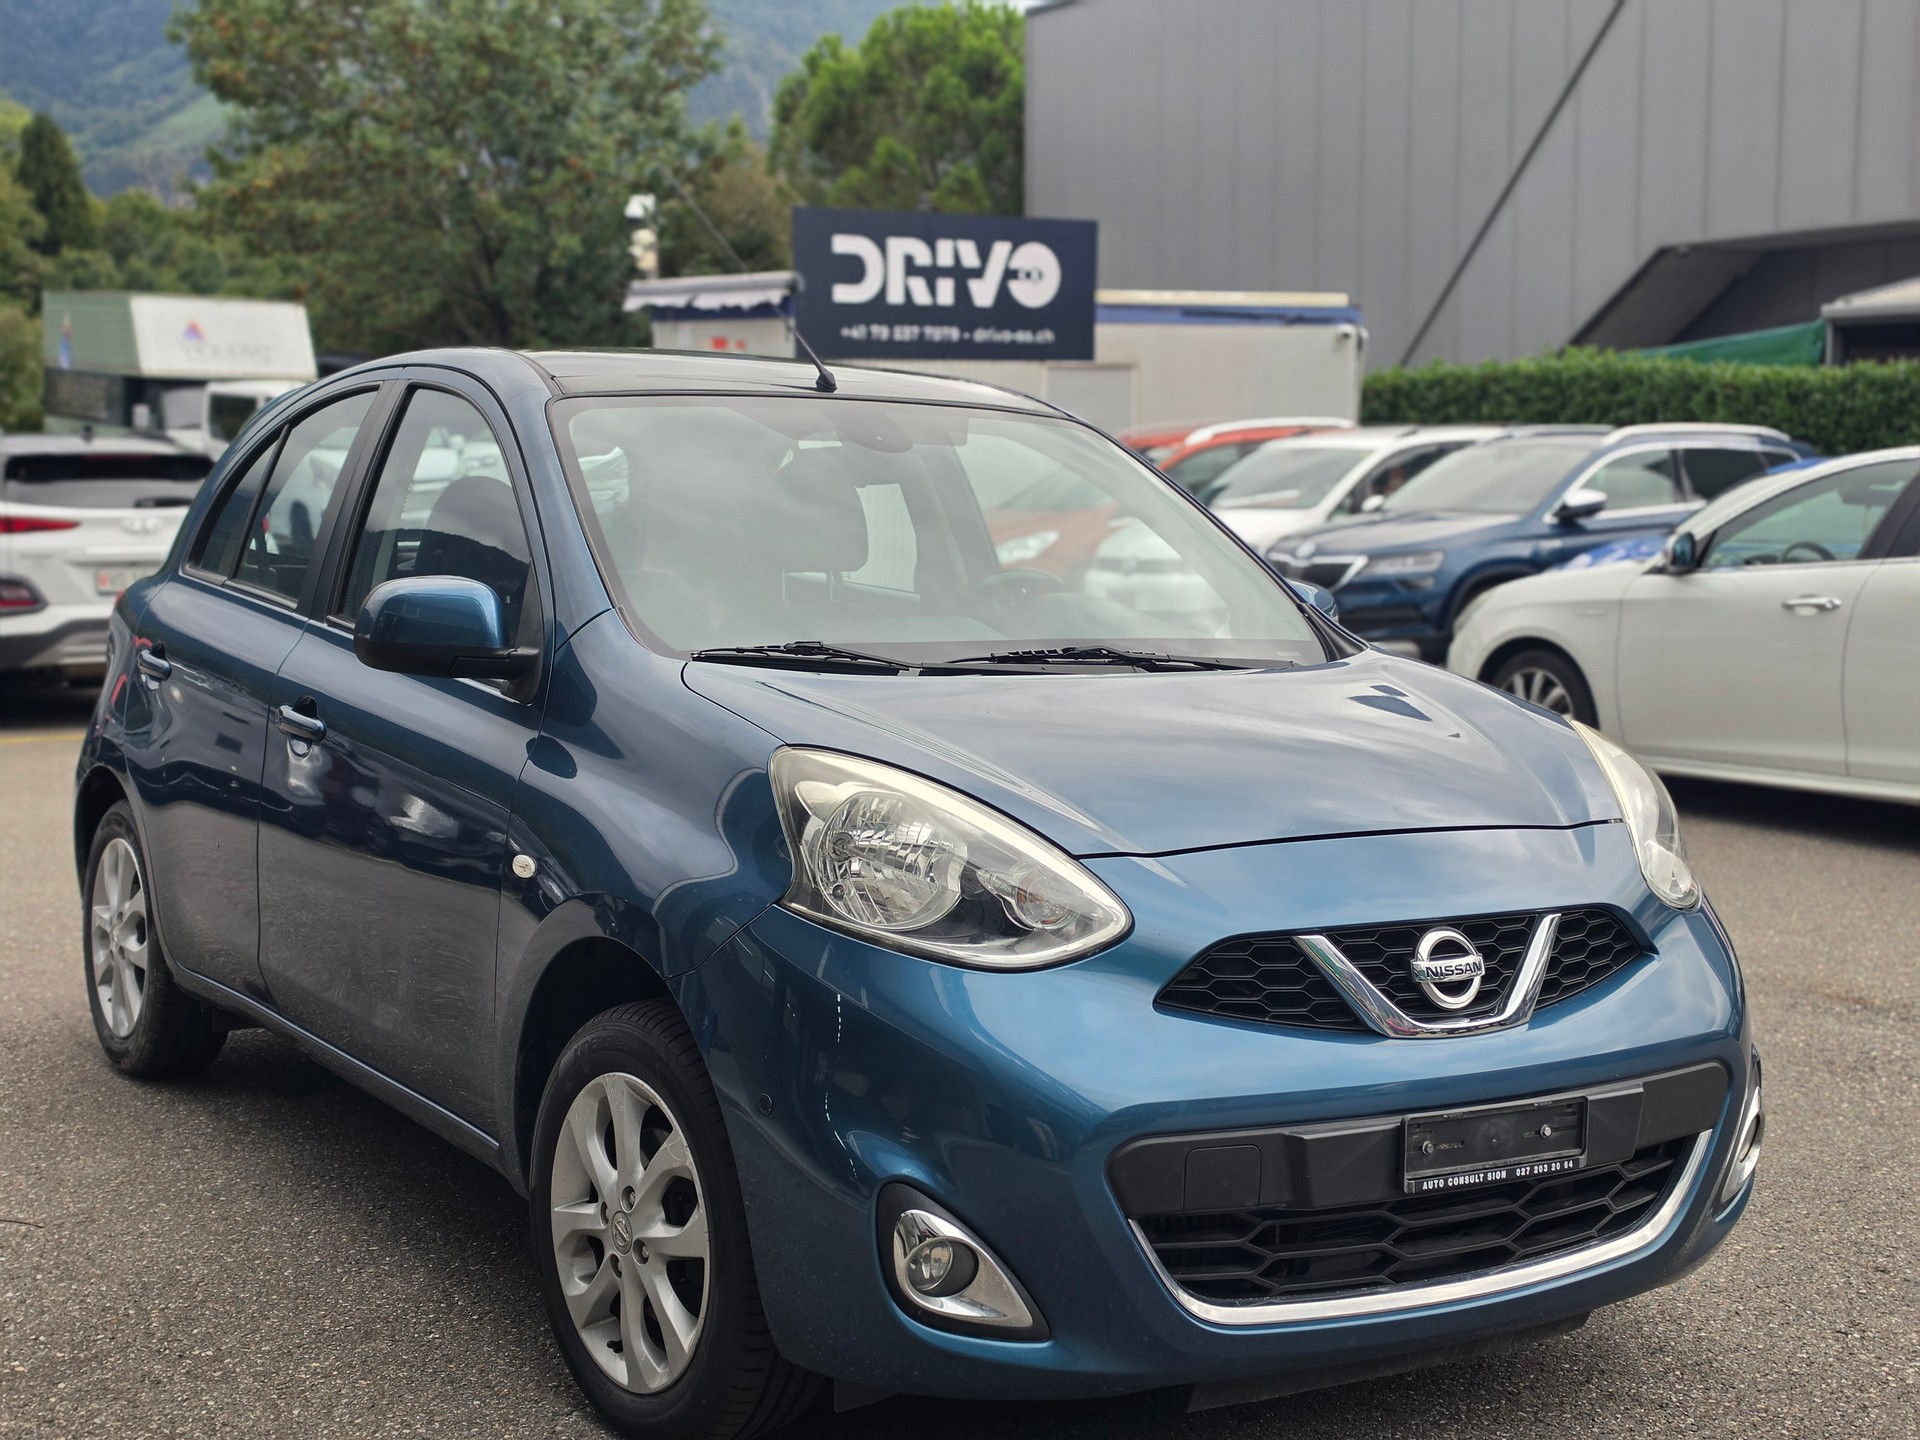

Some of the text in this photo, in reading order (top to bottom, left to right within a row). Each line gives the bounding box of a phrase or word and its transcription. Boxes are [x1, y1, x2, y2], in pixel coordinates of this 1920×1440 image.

[831, 233, 1062, 309] DRIVO
[1425, 962, 1481, 978] NISSAN
[1422, 1179, 1445, 1190] AUTO
[1447, 1173, 1485, 1187] CONSULT
[1487, 1170, 1507, 1181] SION
[1515, 1166, 1531, 1177] 027
[1533, 1164, 1548, 1174] 203
[1550, 1162, 1561, 1171] 20
